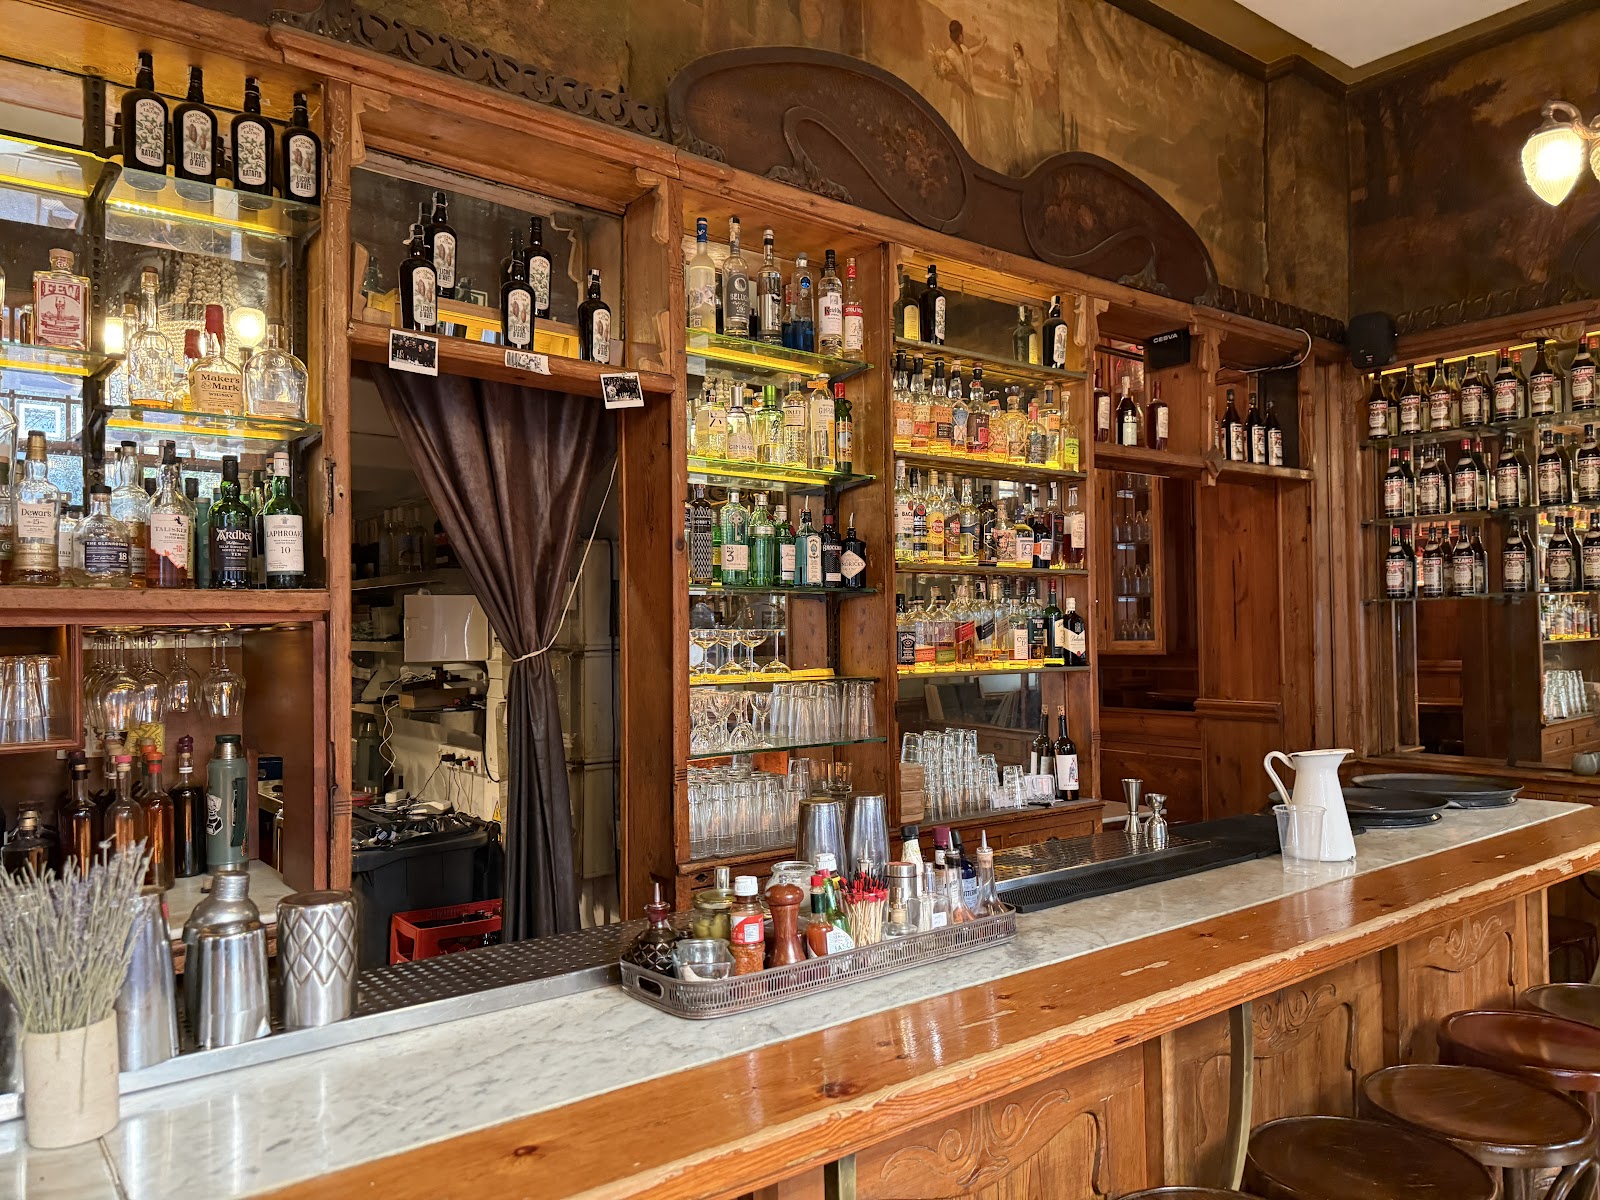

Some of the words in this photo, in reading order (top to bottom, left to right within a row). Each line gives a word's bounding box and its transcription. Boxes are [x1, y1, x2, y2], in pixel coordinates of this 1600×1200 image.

[140, 148, 161, 160] RATAFIA
[190, 152, 205, 160] LICOR
[242, 170, 262, 178] RATAFIA
[44, 282, 77, 296] FEW
[1153, 333, 1178, 344] CESVA
[201, 374, 240, 383] Maker's
[212, 382, 240, 392] Mark
[21, 508, 52, 518] Dewar's
[216, 528, 252, 542] Ardbeg
[176, 544, 182, 552] 10
[281, 546, 290, 554] 10
[118, 552, 127, 560] 18
[726, 550, 734, 562] 3
